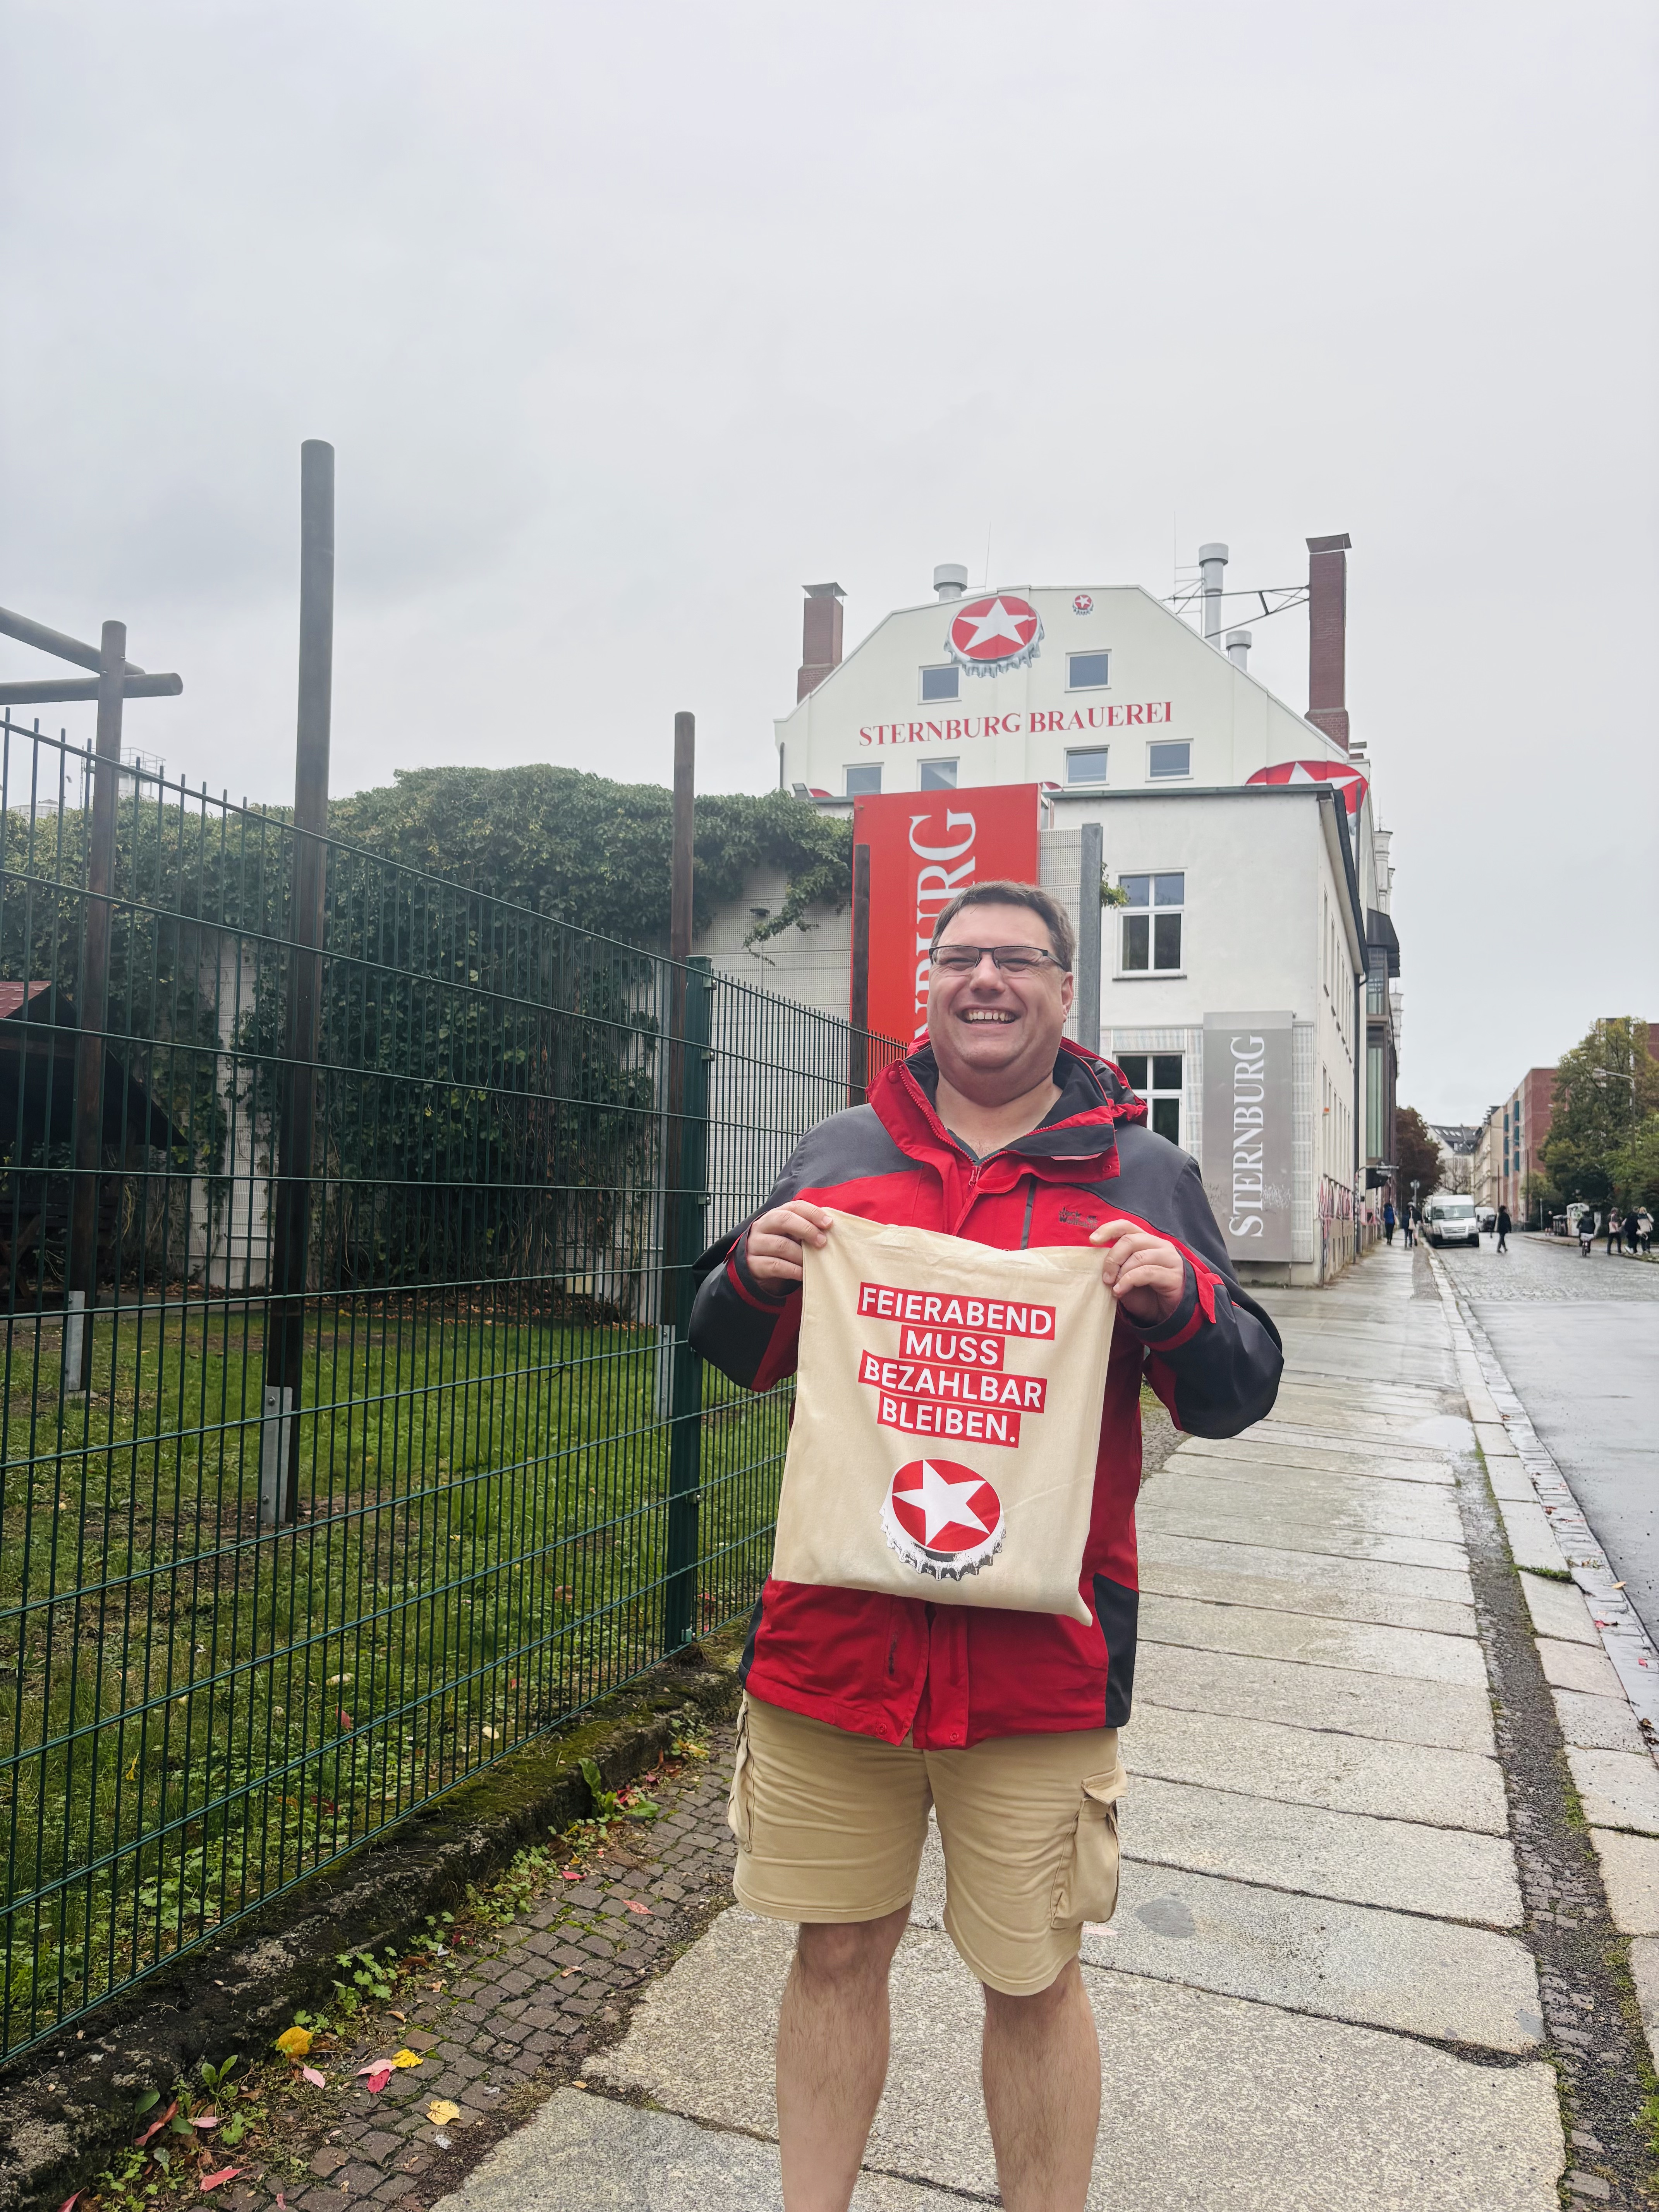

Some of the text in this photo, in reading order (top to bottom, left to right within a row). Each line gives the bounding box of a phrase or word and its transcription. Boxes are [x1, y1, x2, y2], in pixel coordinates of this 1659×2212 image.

[859, 701, 1172, 746] STERNBURG BRAUEREI
[1229, 1035, 1265, 1237] STERNBURG
[861, 1286, 1052, 1335] FEIERABEND
[905, 1329, 998, 1365] MUSS
[864, 1355, 1042, 1408] BEZAHLBAR
[882, 1396, 1016, 1443] BLEIBEN.
